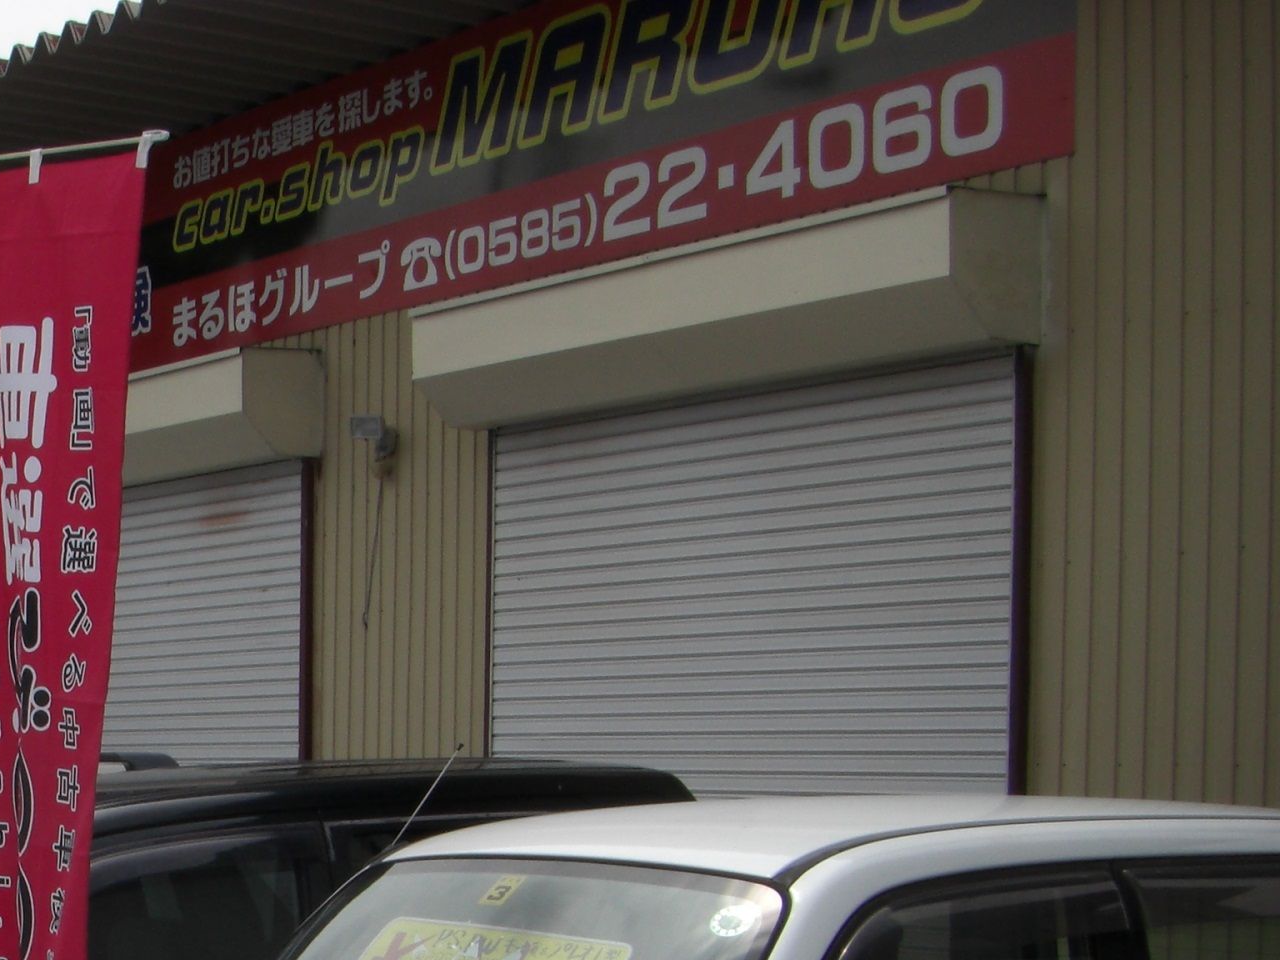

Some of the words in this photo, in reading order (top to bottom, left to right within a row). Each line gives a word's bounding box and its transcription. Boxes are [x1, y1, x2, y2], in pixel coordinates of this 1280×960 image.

[173, 125, 425, 252] car.shop
[429, 0, 986, 174] MARUH
[173, 239, 390, 347] まるほグループ
